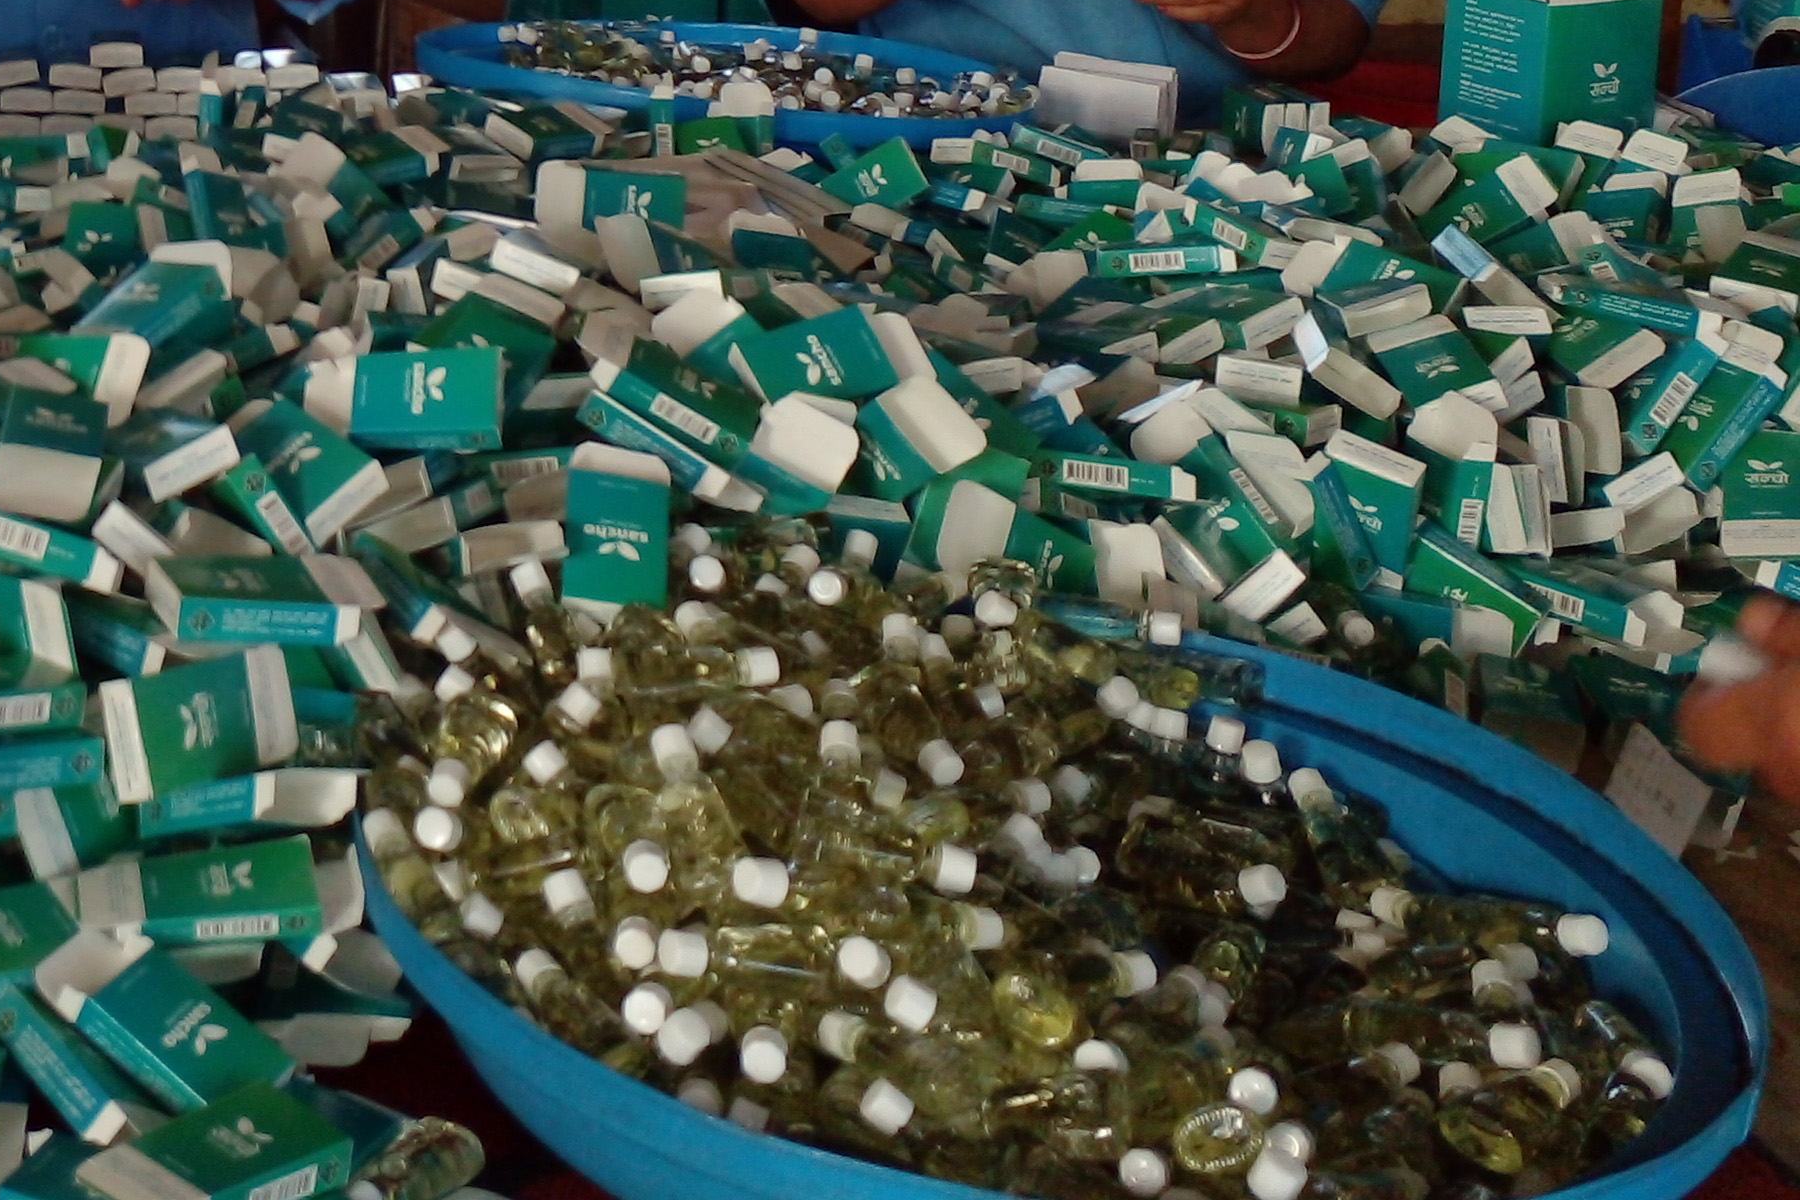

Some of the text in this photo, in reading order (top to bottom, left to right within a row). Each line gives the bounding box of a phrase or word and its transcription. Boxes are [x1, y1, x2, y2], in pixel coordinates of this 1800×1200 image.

[1589, 76, 1620, 97] सन्चो
[1744, 470, 1790, 484] सन्चो
[583, 523, 649, 544] sancho
[162, 1002, 212, 1049] sancho
